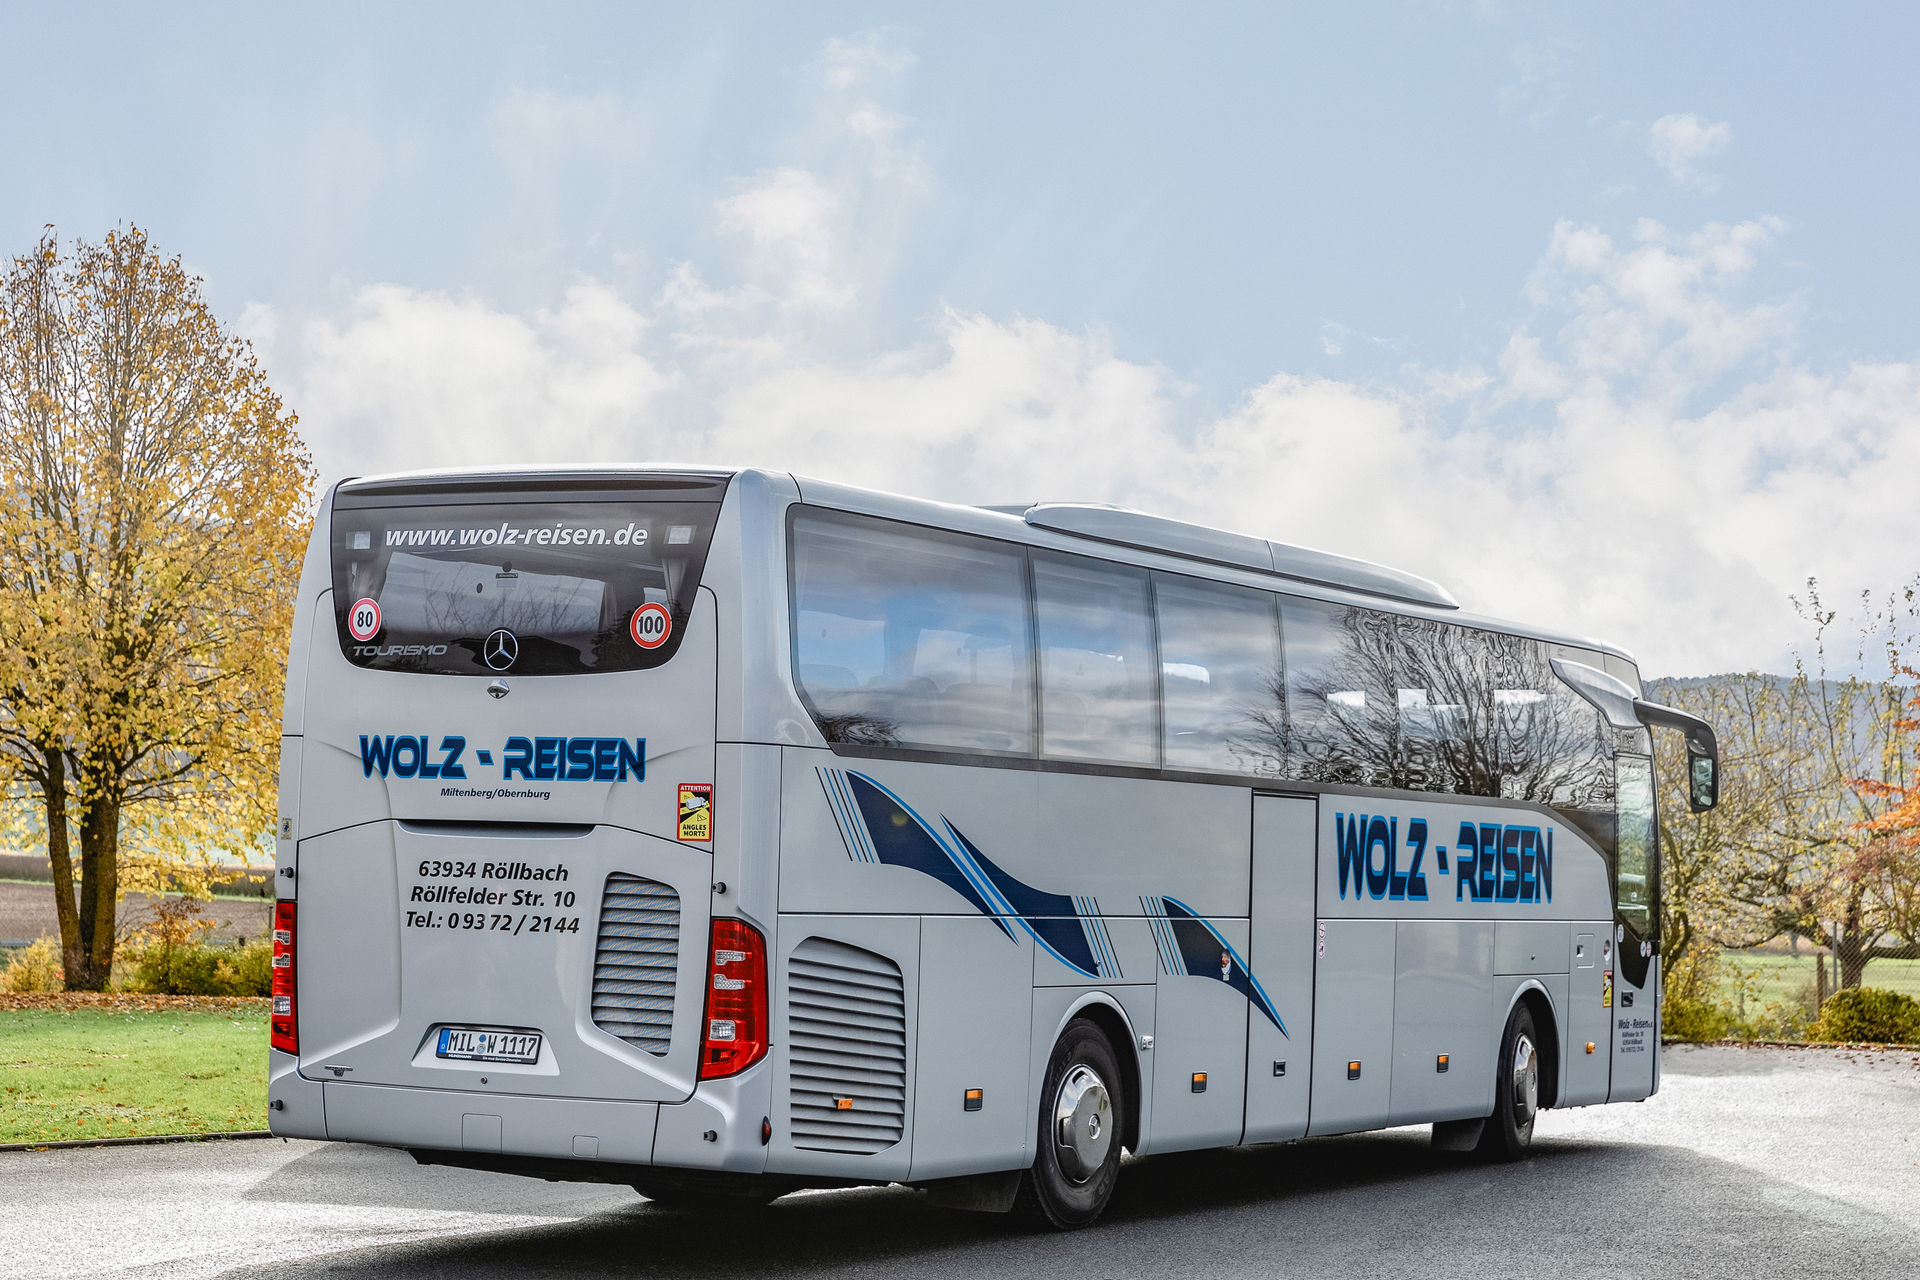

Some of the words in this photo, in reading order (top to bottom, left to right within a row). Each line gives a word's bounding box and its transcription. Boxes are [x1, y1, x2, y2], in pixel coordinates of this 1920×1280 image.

[385, 522, 648, 546] www.wolz-reisen.de
[357, 611, 373, 628] 80
[638, 615, 664, 634] 100
[353, 644, 448, 656] TOURISMO
[359, 734, 467, 779] WOLZ
[503, 736, 647, 783] REISEN
[440, 788, 551, 801] Miltenberg/Obernburg
[1335, 812, 1429, 901] WOLZ
[1456, 821, 1554, 904] REISEN
[418, 860, 477, 878] 63934
[481, 862, 569, 881] Röllbach
[410, 886, 508, 905] Röllfelder
[512, 889, 546, 907] Str.
[553, 891, 576, 908] 10
[406, 911, 443, 929] Tel.:
